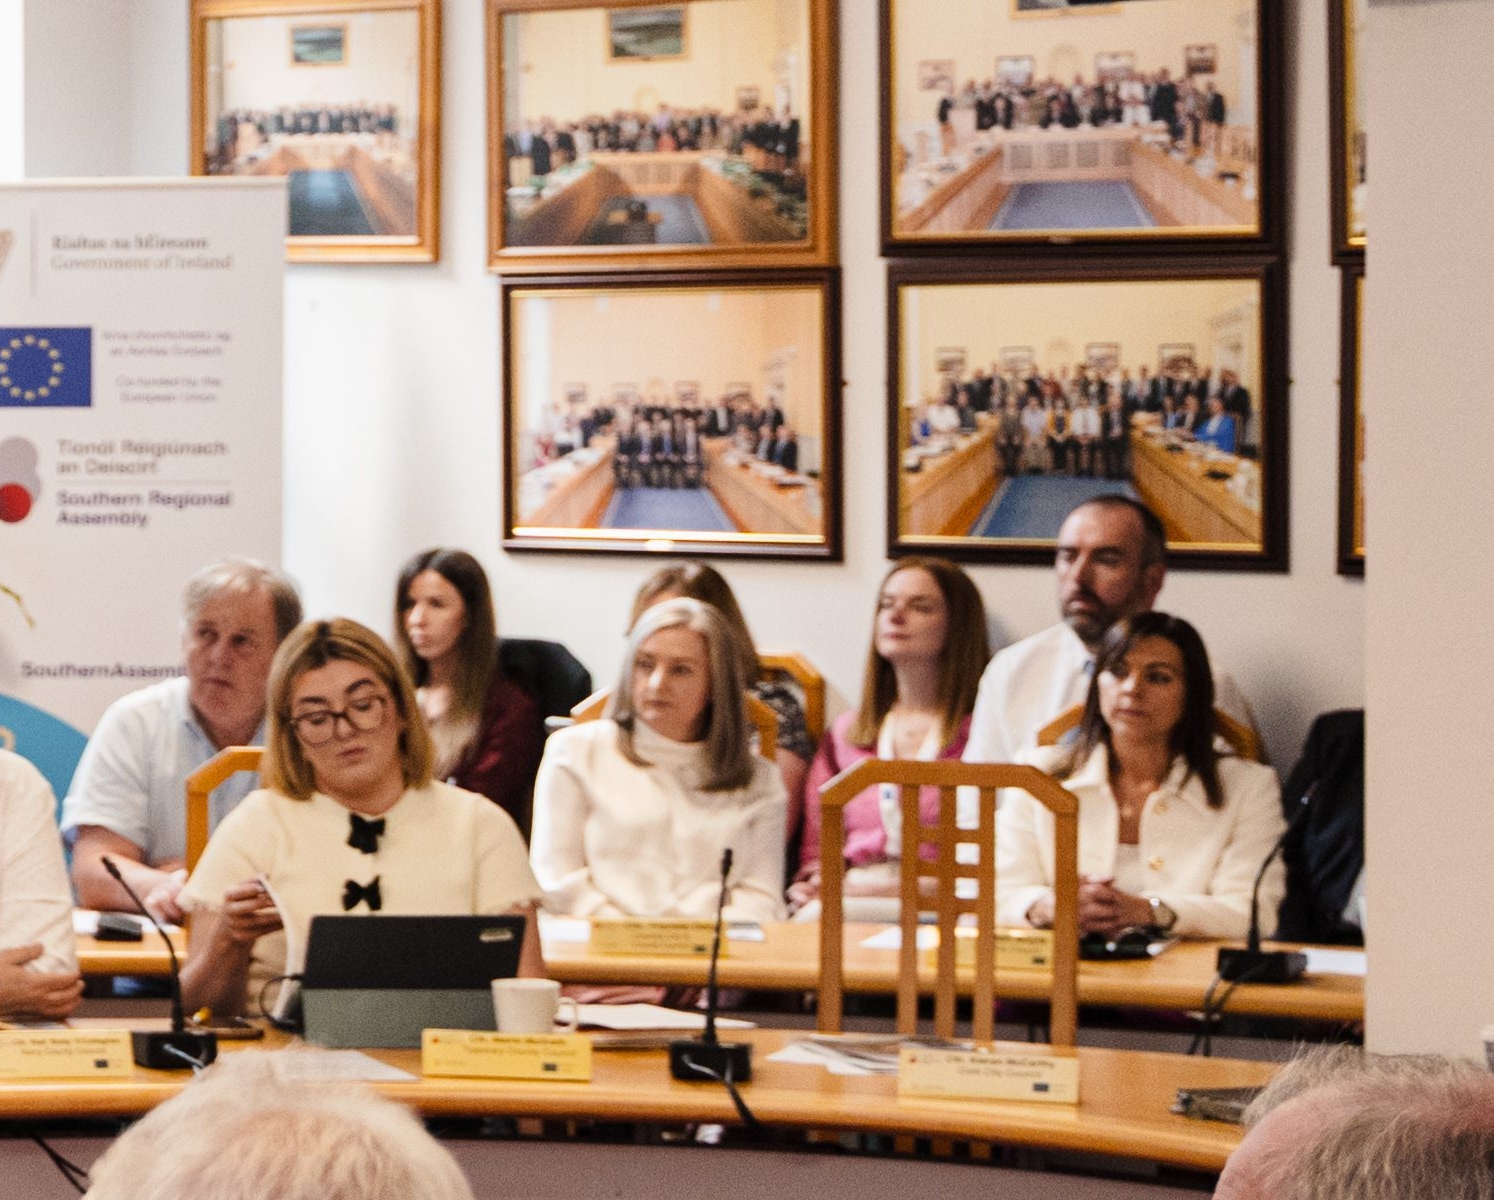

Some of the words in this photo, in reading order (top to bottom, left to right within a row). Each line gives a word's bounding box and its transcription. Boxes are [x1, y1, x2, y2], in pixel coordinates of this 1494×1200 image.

[57, 491, 141, 507] Southern
[148, 490, 232, 510] Regional
[57, 511, 149, 529] Assembly
